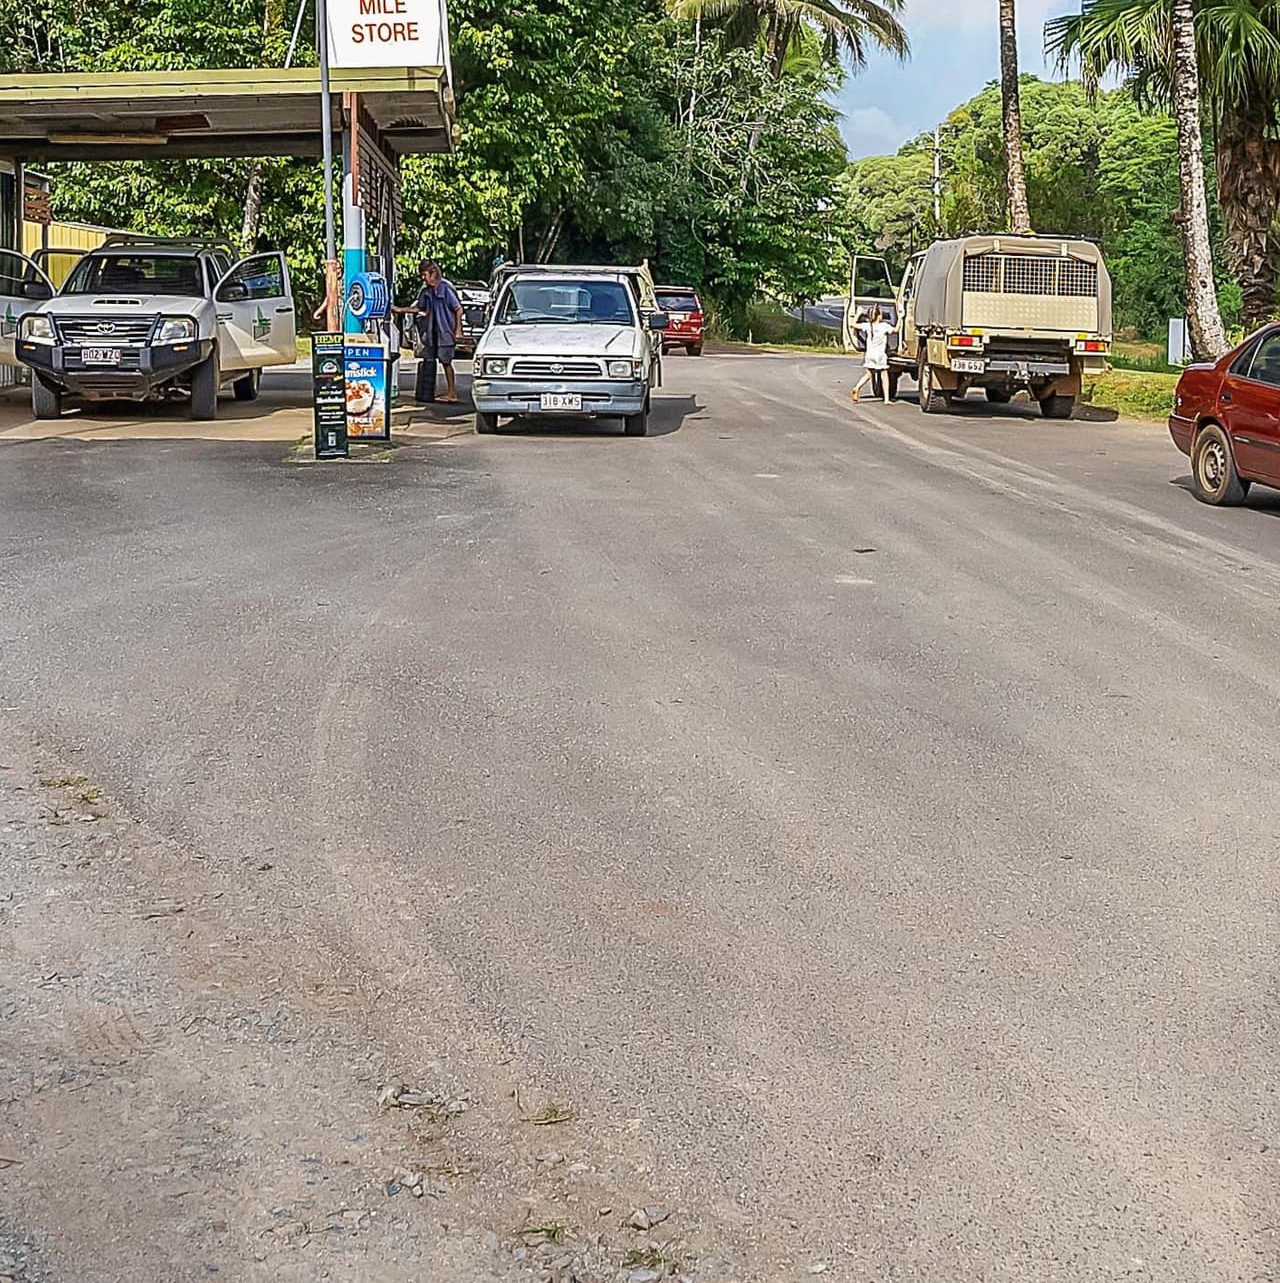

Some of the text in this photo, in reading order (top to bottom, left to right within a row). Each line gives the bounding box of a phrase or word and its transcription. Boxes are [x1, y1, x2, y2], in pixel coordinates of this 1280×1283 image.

[351, 22, 419, 43] STORE
[314, 335, 343, 344] HEMP
[344, 348, 369, 356] PEN
[345, 367, 377, 378] mstick
